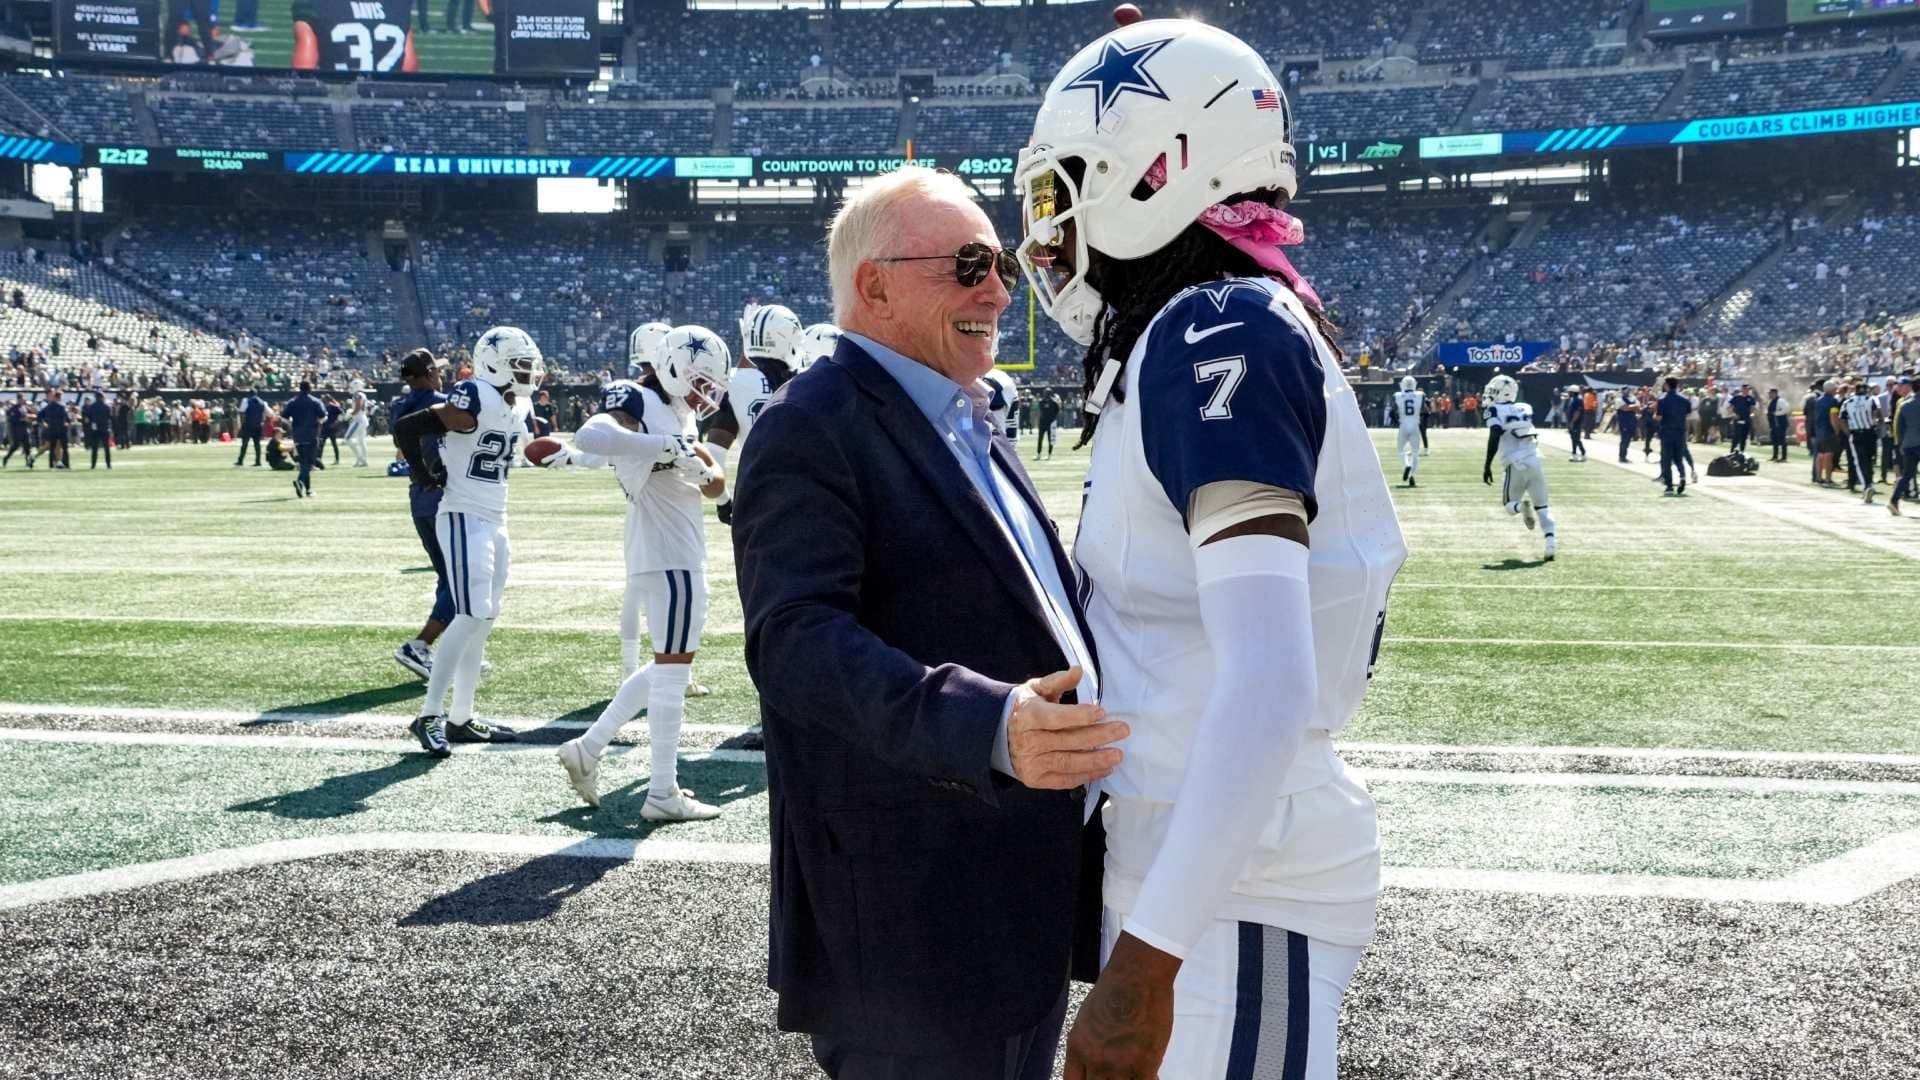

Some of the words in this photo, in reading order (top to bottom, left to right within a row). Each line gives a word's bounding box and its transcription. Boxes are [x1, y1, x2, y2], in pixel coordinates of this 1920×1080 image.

[350, 1, 386, 19] DAVIS
[517, 23, 535, 31] AVG
[554, 16, 585, 24] RETURN
[96, 42, 128, 53] YEARS
[331, 22, 405, 71] 32
[1699, 118, 1783, 137] COUGARS
[1790, 113, 1848, 130] CLIMB
[99, 148, 148, 164] 12:12
[201, 150, 232, 159] RAFFLE
[394, 157, 451, 173] KEAN
[457, 158, 571, 174] UNIVERSITY
[762, 160, 853, 173] COUNTDOWN
[856, 159, 875, 171] TO
[958, 158, 1013, 174] 49:02
[1193, 355, 1247, 421] 7
[605, 393, 629, 410] 27
[1405, 400, 1414, 416] 6
